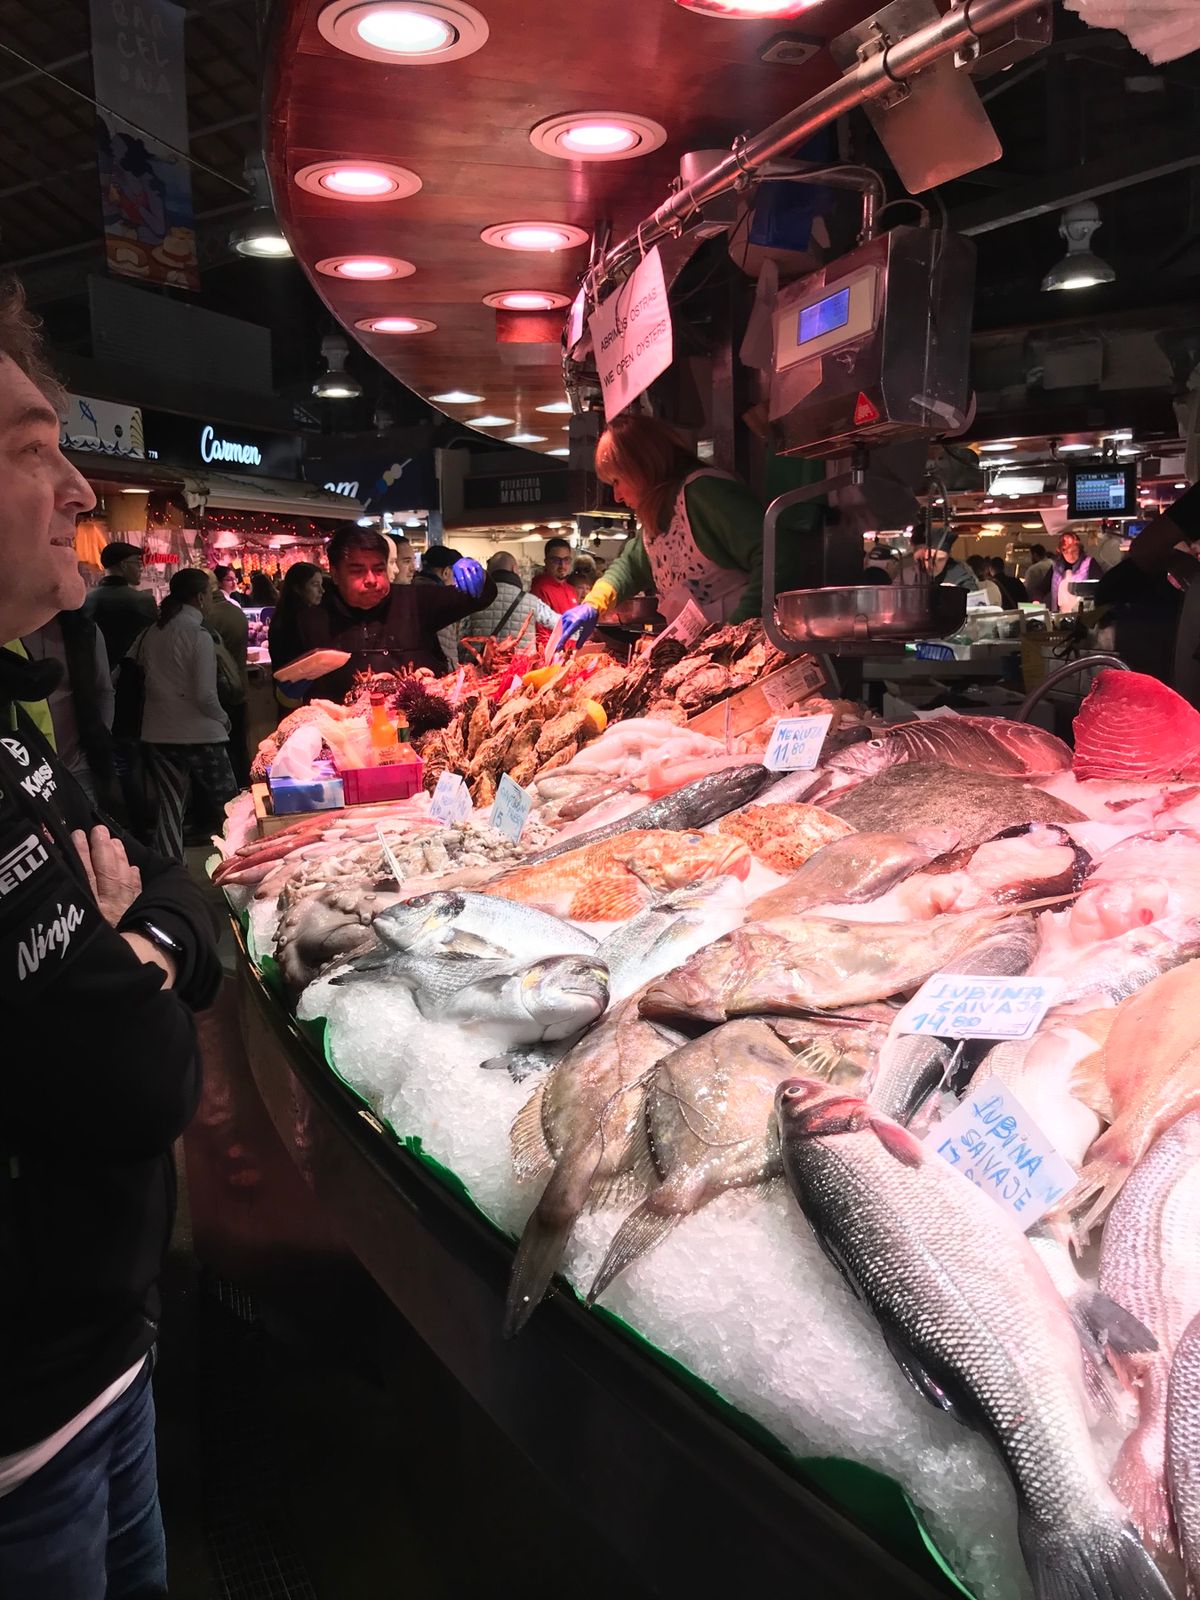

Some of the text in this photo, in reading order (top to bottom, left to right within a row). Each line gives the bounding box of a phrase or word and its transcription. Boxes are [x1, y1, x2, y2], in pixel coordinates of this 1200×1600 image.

[630, 287, 658, 322] OSTRAS
[603, 319, 667, 388] WE OPEN OYSTERS
[200, 425, 262, 466] Carmen
[500, 487, 542, 504] MANOLO
[17, 903, 85, 981] Ninja
